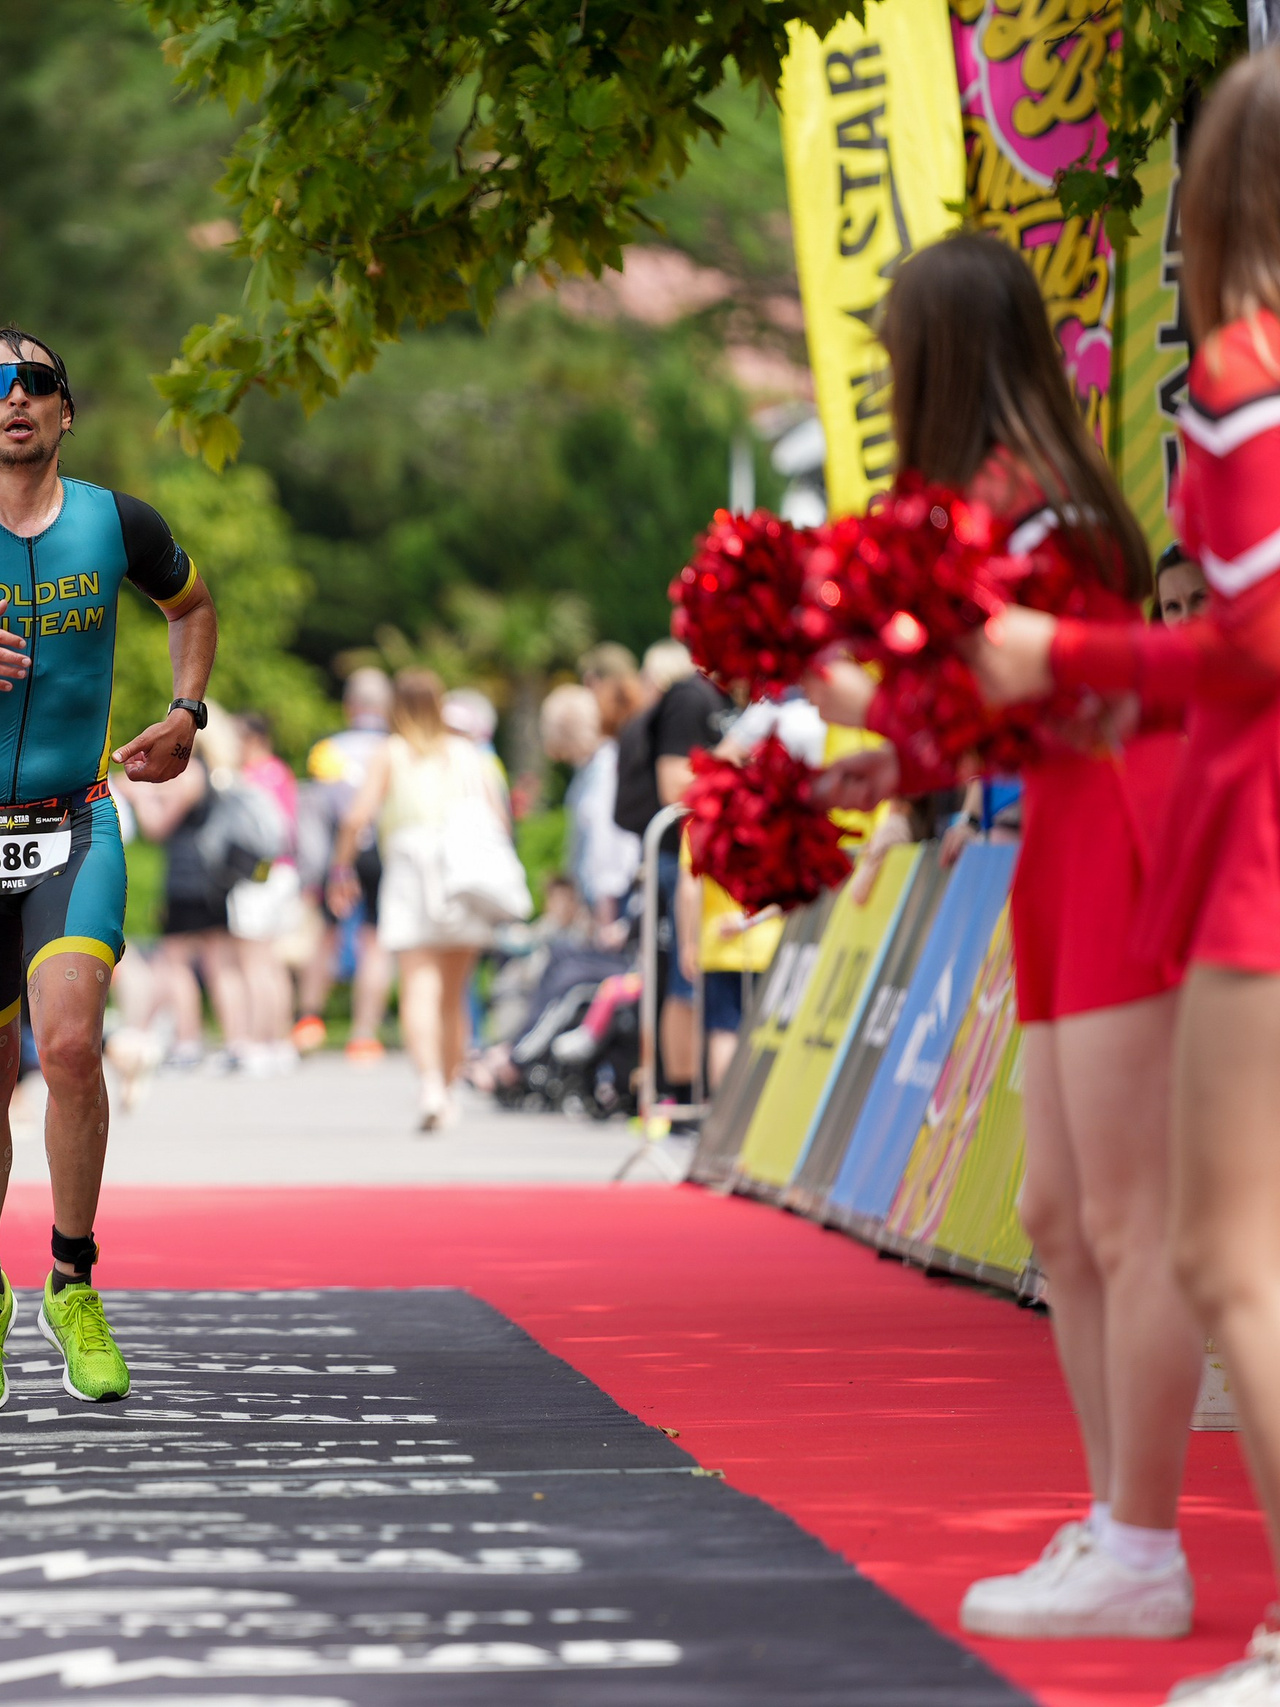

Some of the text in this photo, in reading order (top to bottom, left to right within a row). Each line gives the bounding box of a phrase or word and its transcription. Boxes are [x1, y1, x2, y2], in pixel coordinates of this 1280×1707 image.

[826, 38, 888, 257] STAR
[18, 605, 104, 638] TEAM
[13, 814, 30, 823] STAR
[1, 879, 27, 889] PAVEL
[123, 1409, 437, 1423] STAR
